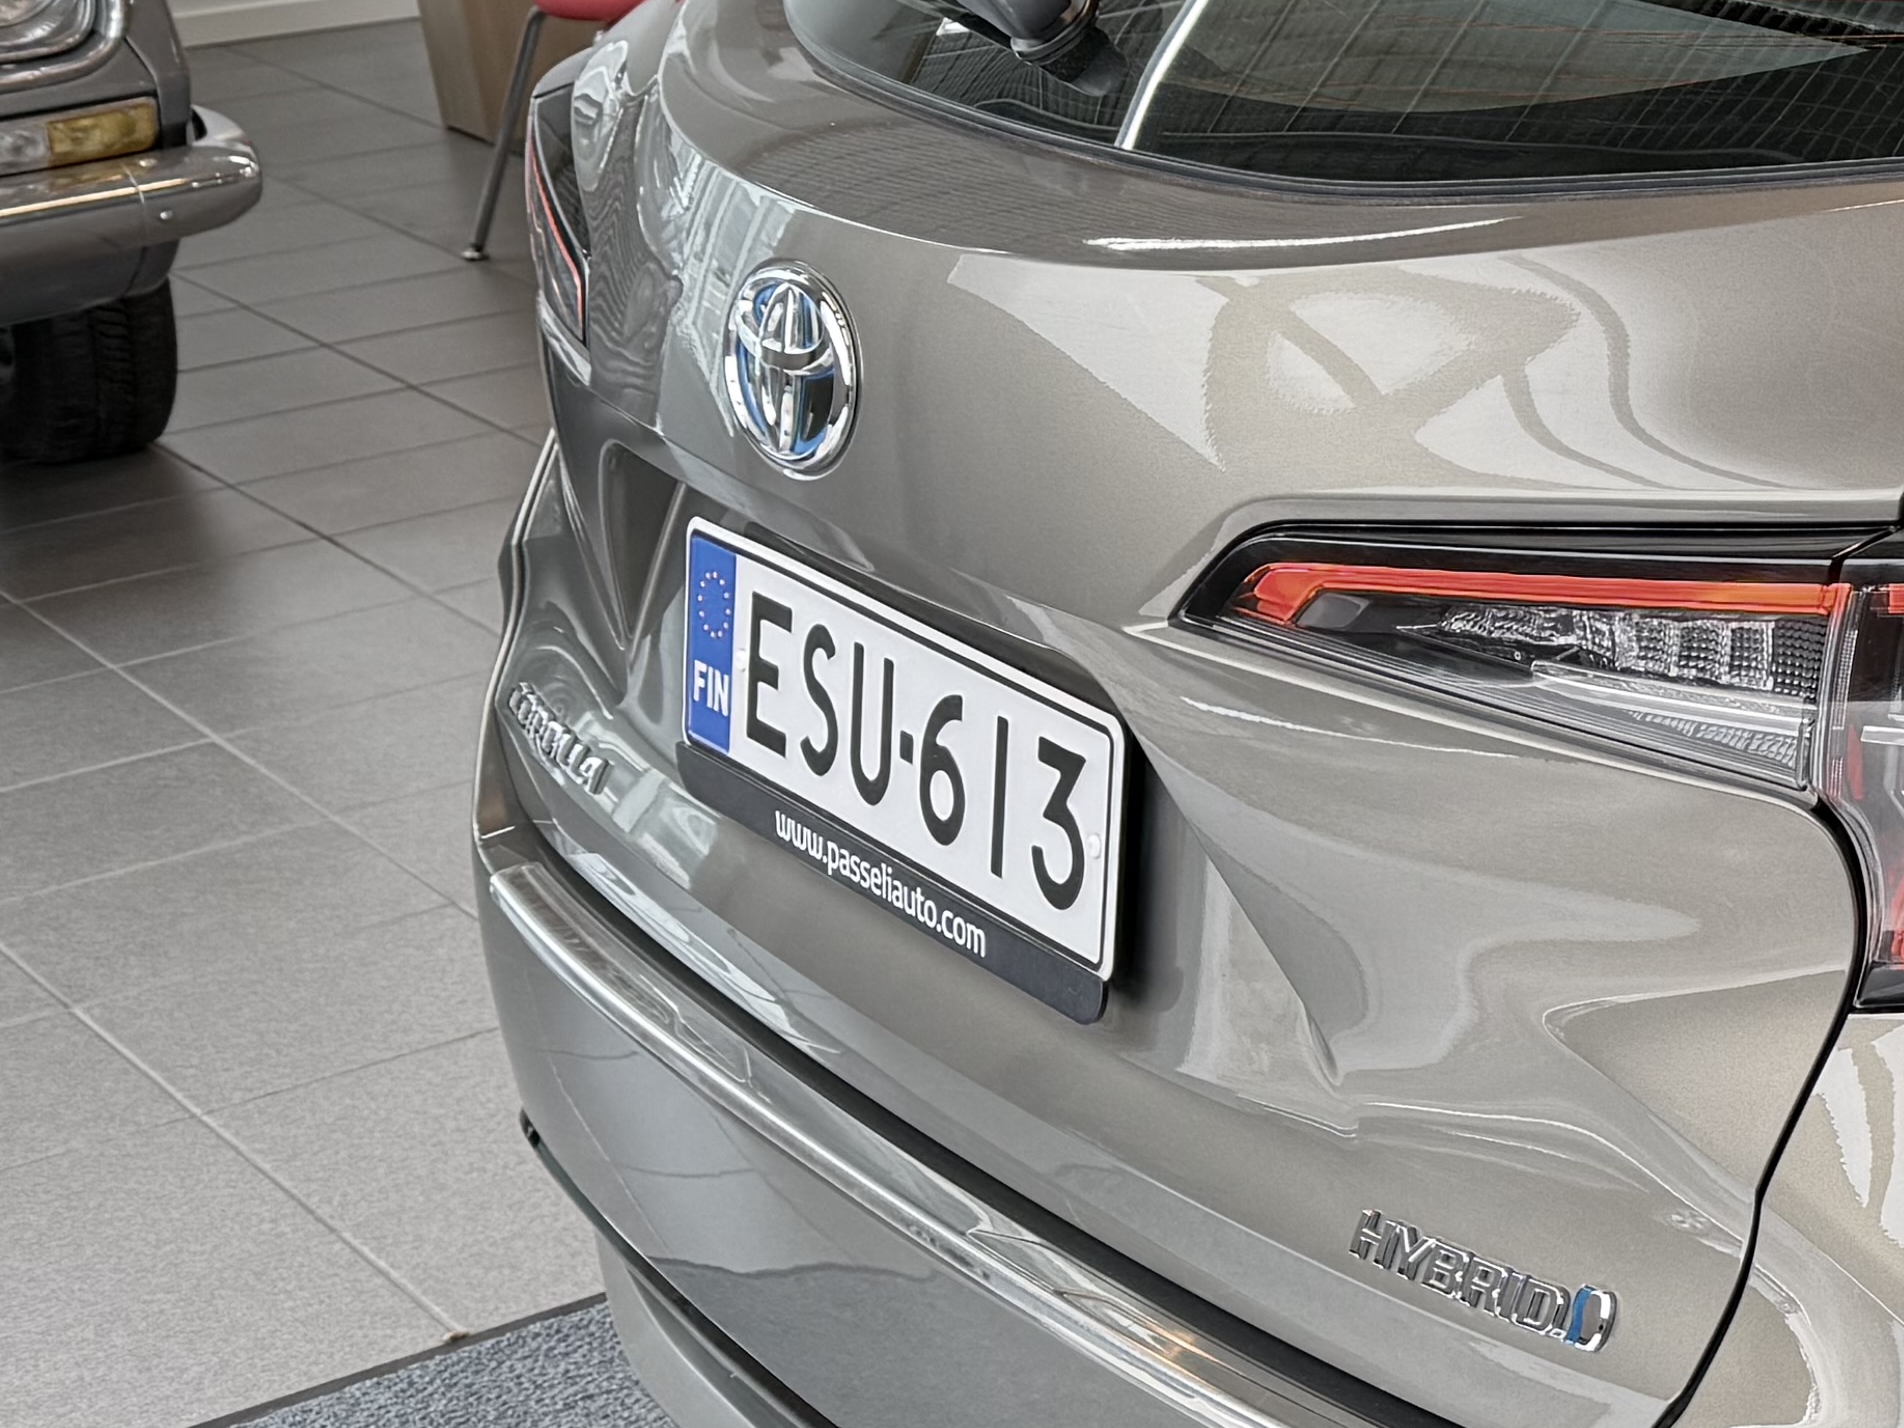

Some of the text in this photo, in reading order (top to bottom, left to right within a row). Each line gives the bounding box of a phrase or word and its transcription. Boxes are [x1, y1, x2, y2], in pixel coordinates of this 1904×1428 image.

[509, 682, 614, 795] COROLLA
[692, 661, 730, 719] FIN
[747, 590, 1087, 911] ESU-613
[775, 809, 987, 959] www.passeliauto.com
[1349, 1208, 1572, 1337] HYBRID
